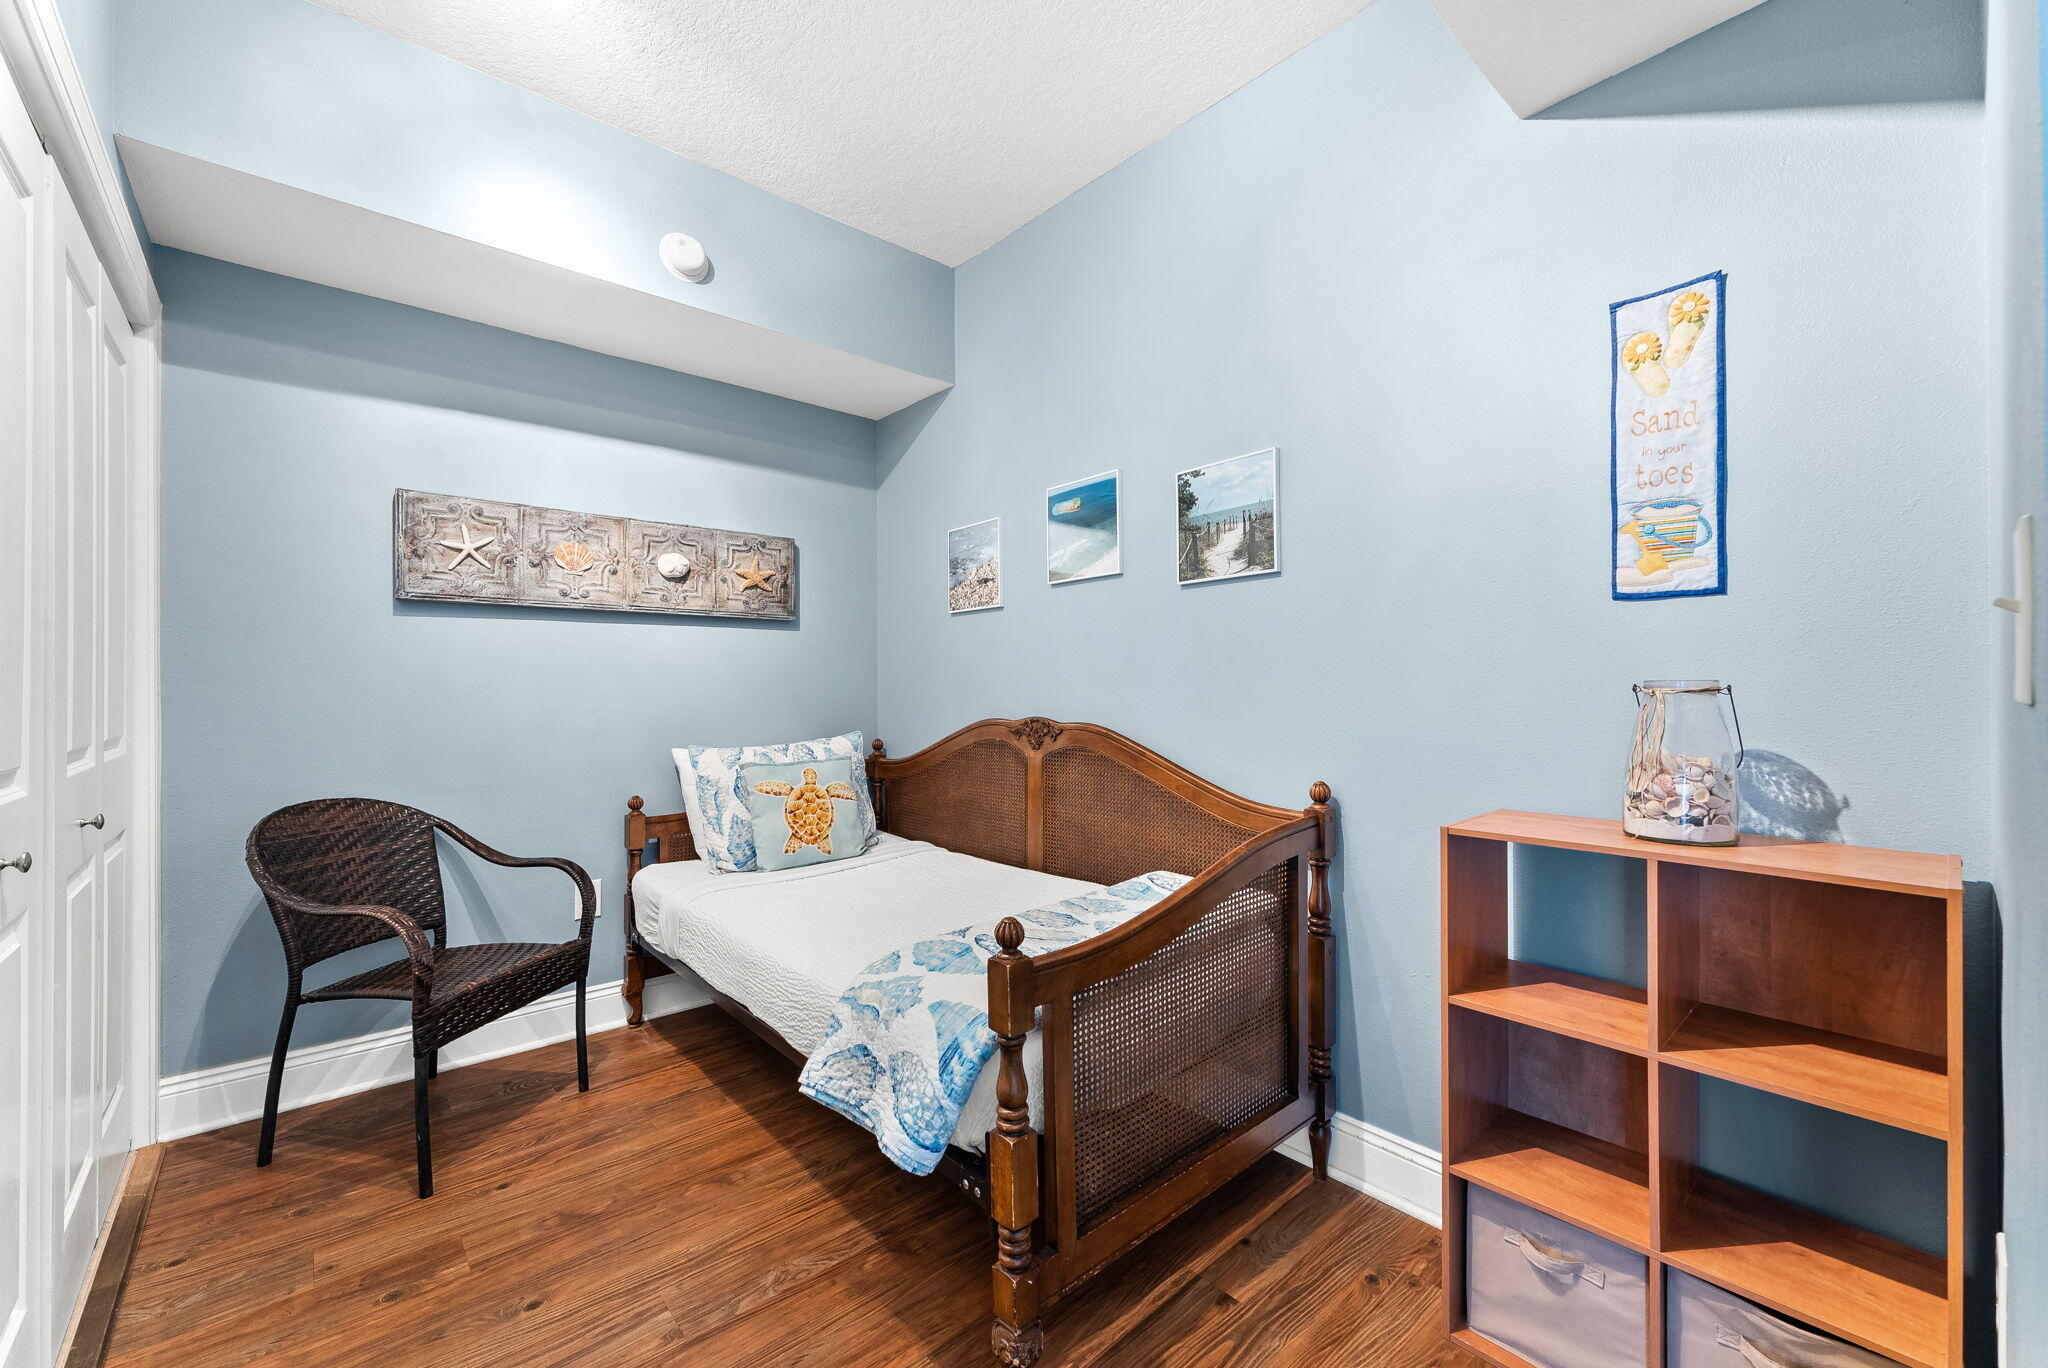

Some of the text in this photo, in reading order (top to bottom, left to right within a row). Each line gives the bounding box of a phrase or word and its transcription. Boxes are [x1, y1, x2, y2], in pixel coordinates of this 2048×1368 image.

[1630, 399, 1701, 437] Sand
[1641, 442, 1687, 461] in your
[1635, 462, 1694, 490] toes
